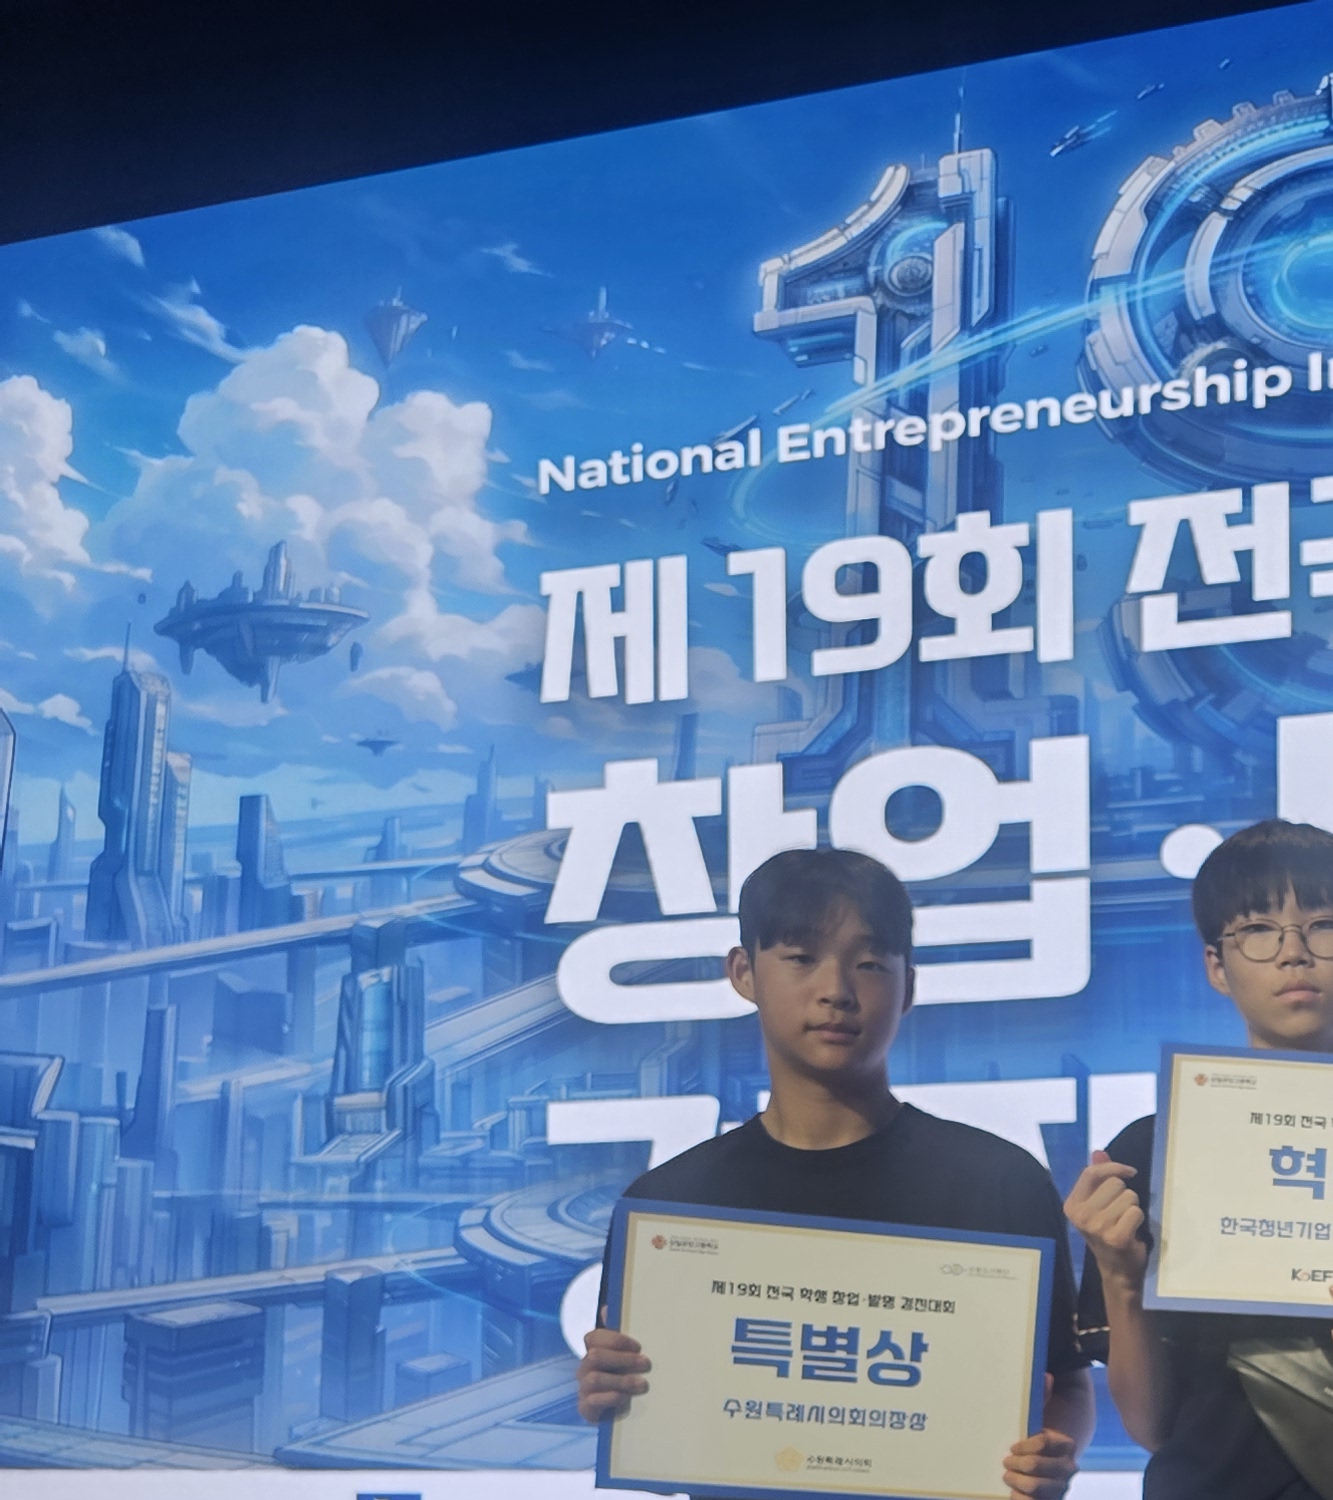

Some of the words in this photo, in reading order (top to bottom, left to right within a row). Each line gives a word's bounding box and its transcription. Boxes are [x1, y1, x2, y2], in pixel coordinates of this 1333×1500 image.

[538, 427, 762, 495] National
[778, 363, 1293, 465] Entrepreneurship
[1301, 1115, 1327, 1130] 전국
[766, 1285, 794, 1301] 전국
[800, 1287, 828, 1303] 학생
[900, 1296, 955, 1314] 경진대회
[731, 1318, 929, 1388] 특별상
[723, 1398, 928, 1431] 수원특례시의회의장상
